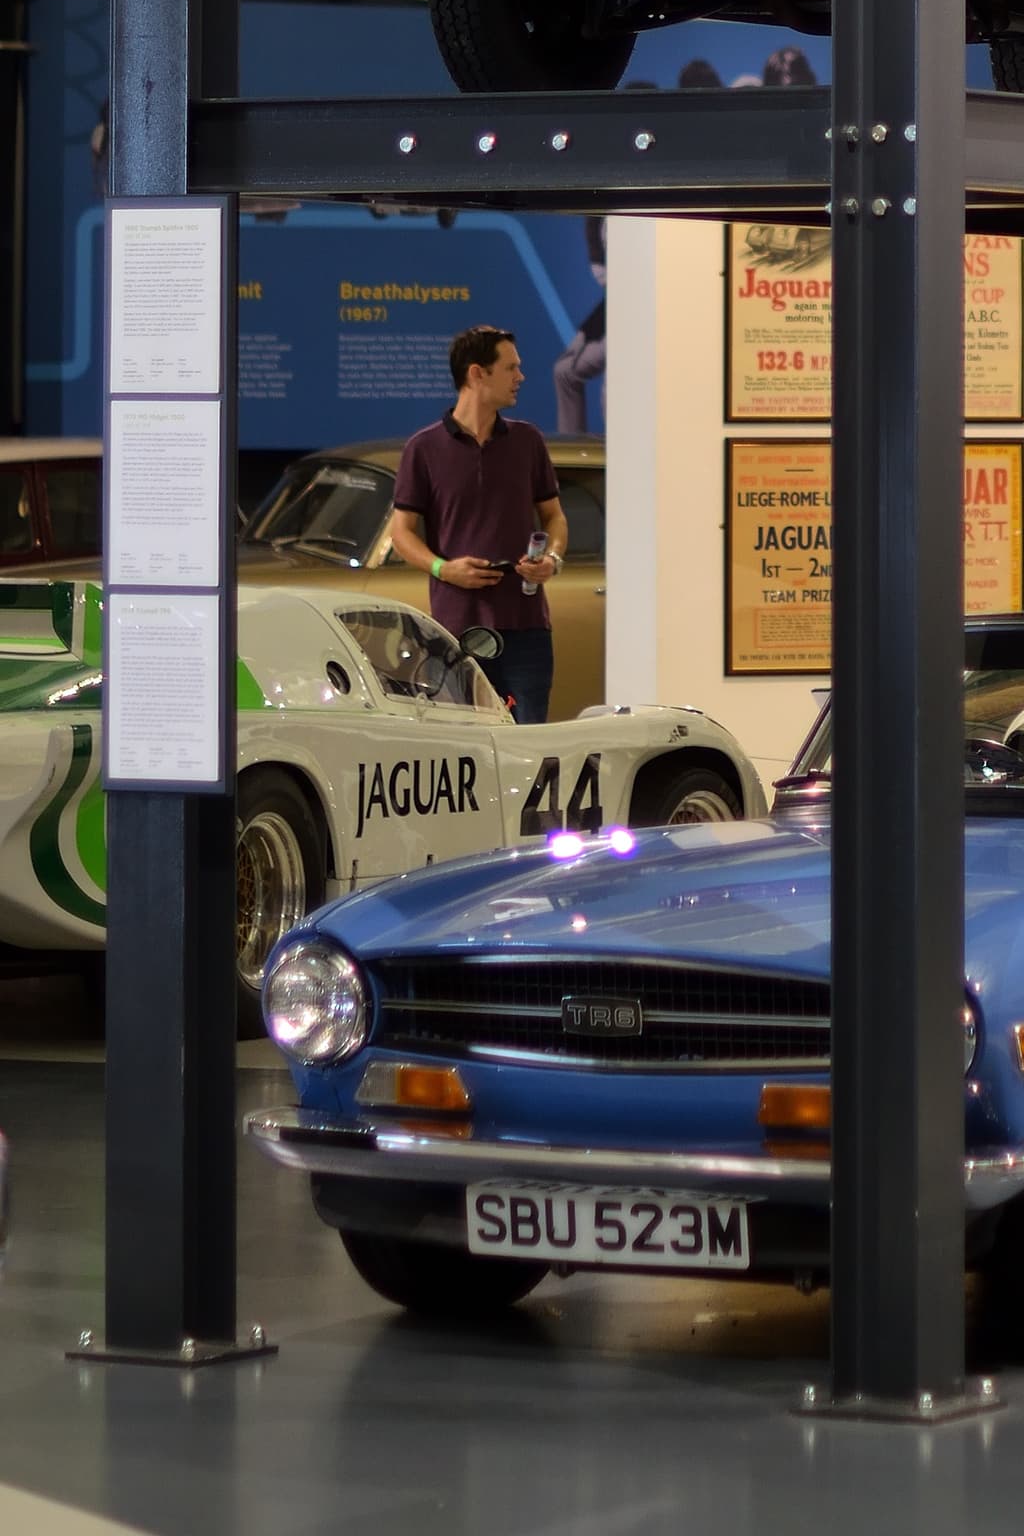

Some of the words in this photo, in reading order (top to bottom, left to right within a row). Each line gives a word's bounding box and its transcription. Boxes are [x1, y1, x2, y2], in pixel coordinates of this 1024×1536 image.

[340, 281, 470, 304] Breathalysers
[972, 287, 1004, 304] CUP
[339, 305, 388, 323] (1967)
[761, 589, 797, 603] TEAM
[356, 755, 480, 839] JAGUAR
[519, 753, 603, 837] 44
[567, 1004, 637, 1029] TR6
[475, 1194, 578, 1248] SBU
[594, 1200, 744, 1259] 523M
